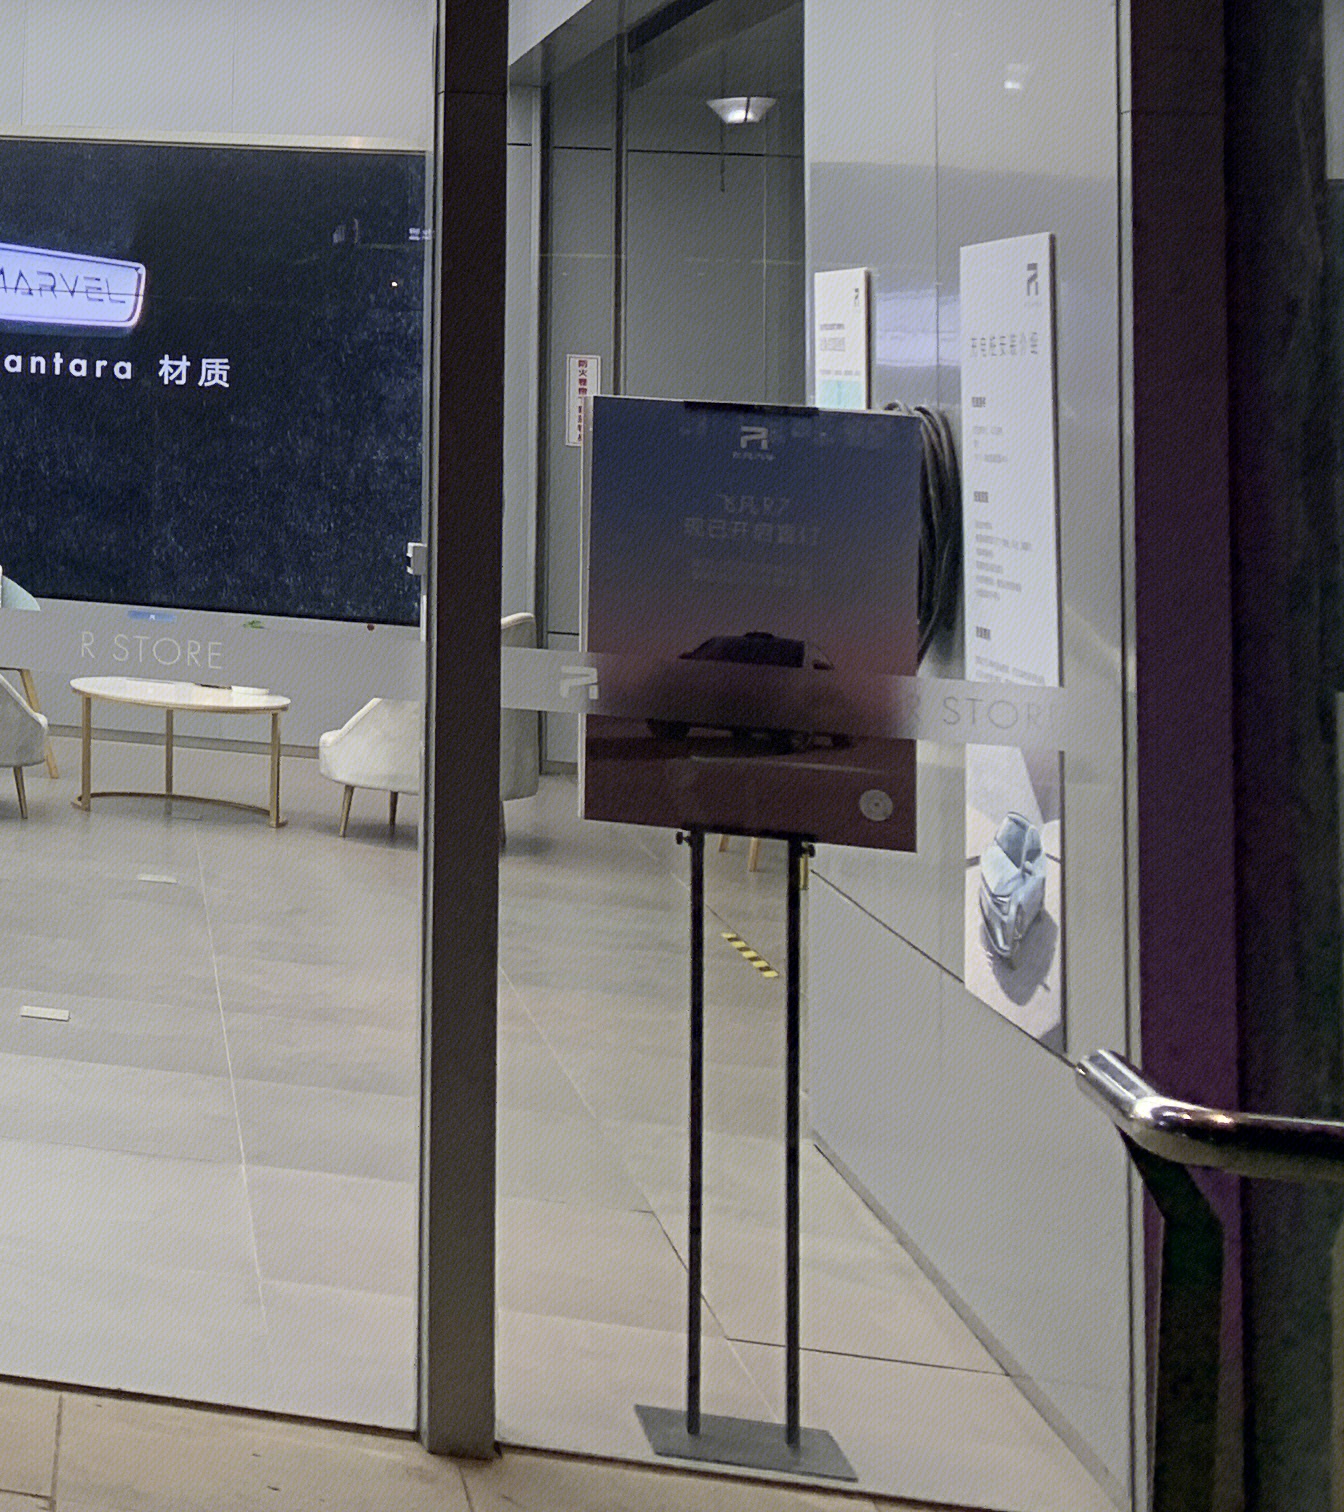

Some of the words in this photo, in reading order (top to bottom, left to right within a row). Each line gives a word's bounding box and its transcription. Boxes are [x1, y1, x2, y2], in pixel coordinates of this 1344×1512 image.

[159, 354, 231, 389] 材质
[80, 631, 95, 660] R
[112, 634, 224, 670] STORE
